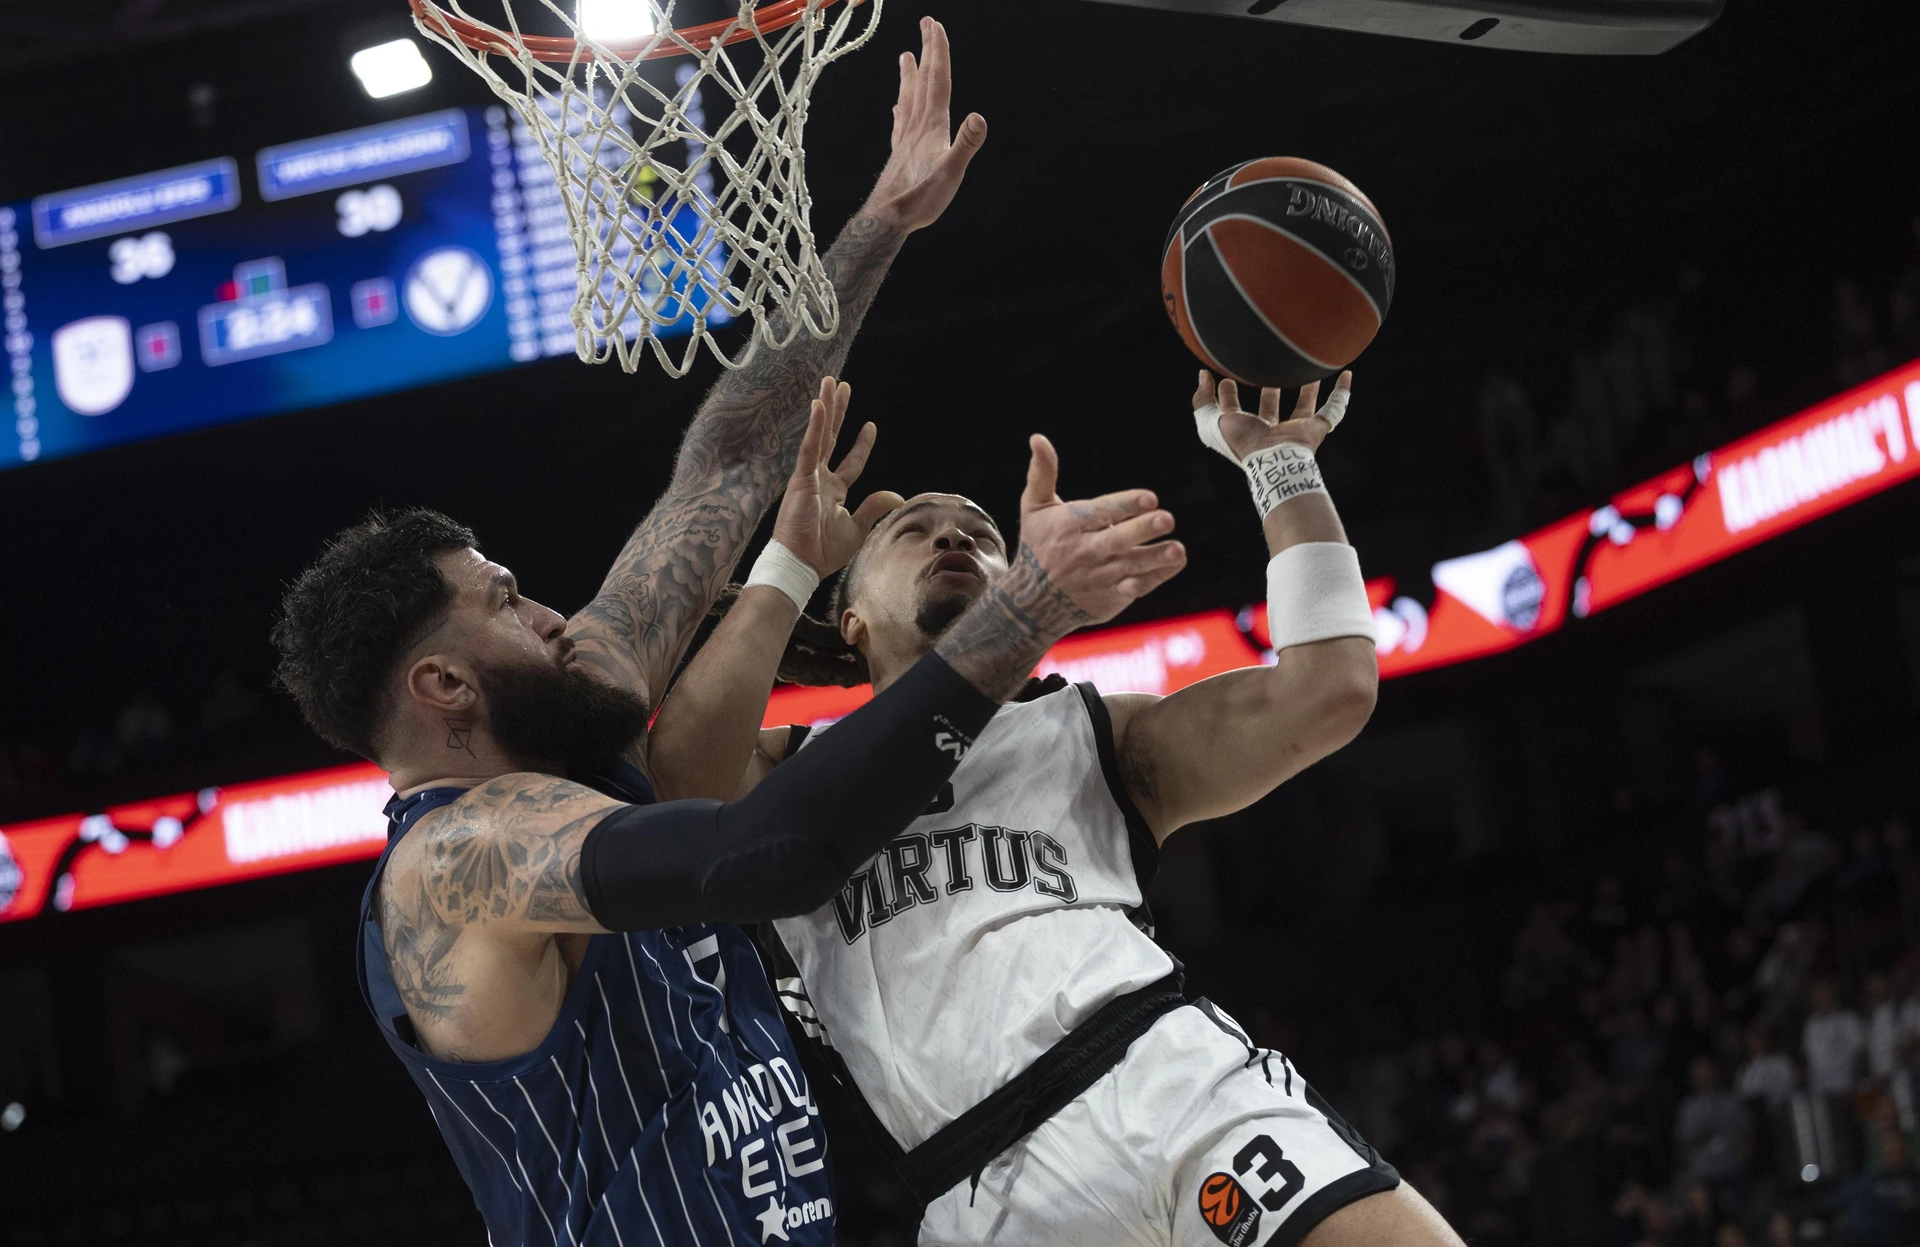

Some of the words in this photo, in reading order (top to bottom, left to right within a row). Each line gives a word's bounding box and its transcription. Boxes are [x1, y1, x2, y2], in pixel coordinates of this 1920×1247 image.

[1256, 449, 1306, 471] KILL
[830, 822, 1079, 946] VIRTUS
[682, 933, 730, 1034] 7
[1232, 1134, 1306, 1212] 3
[1241, 1206, 1260, 1236] dhabi
